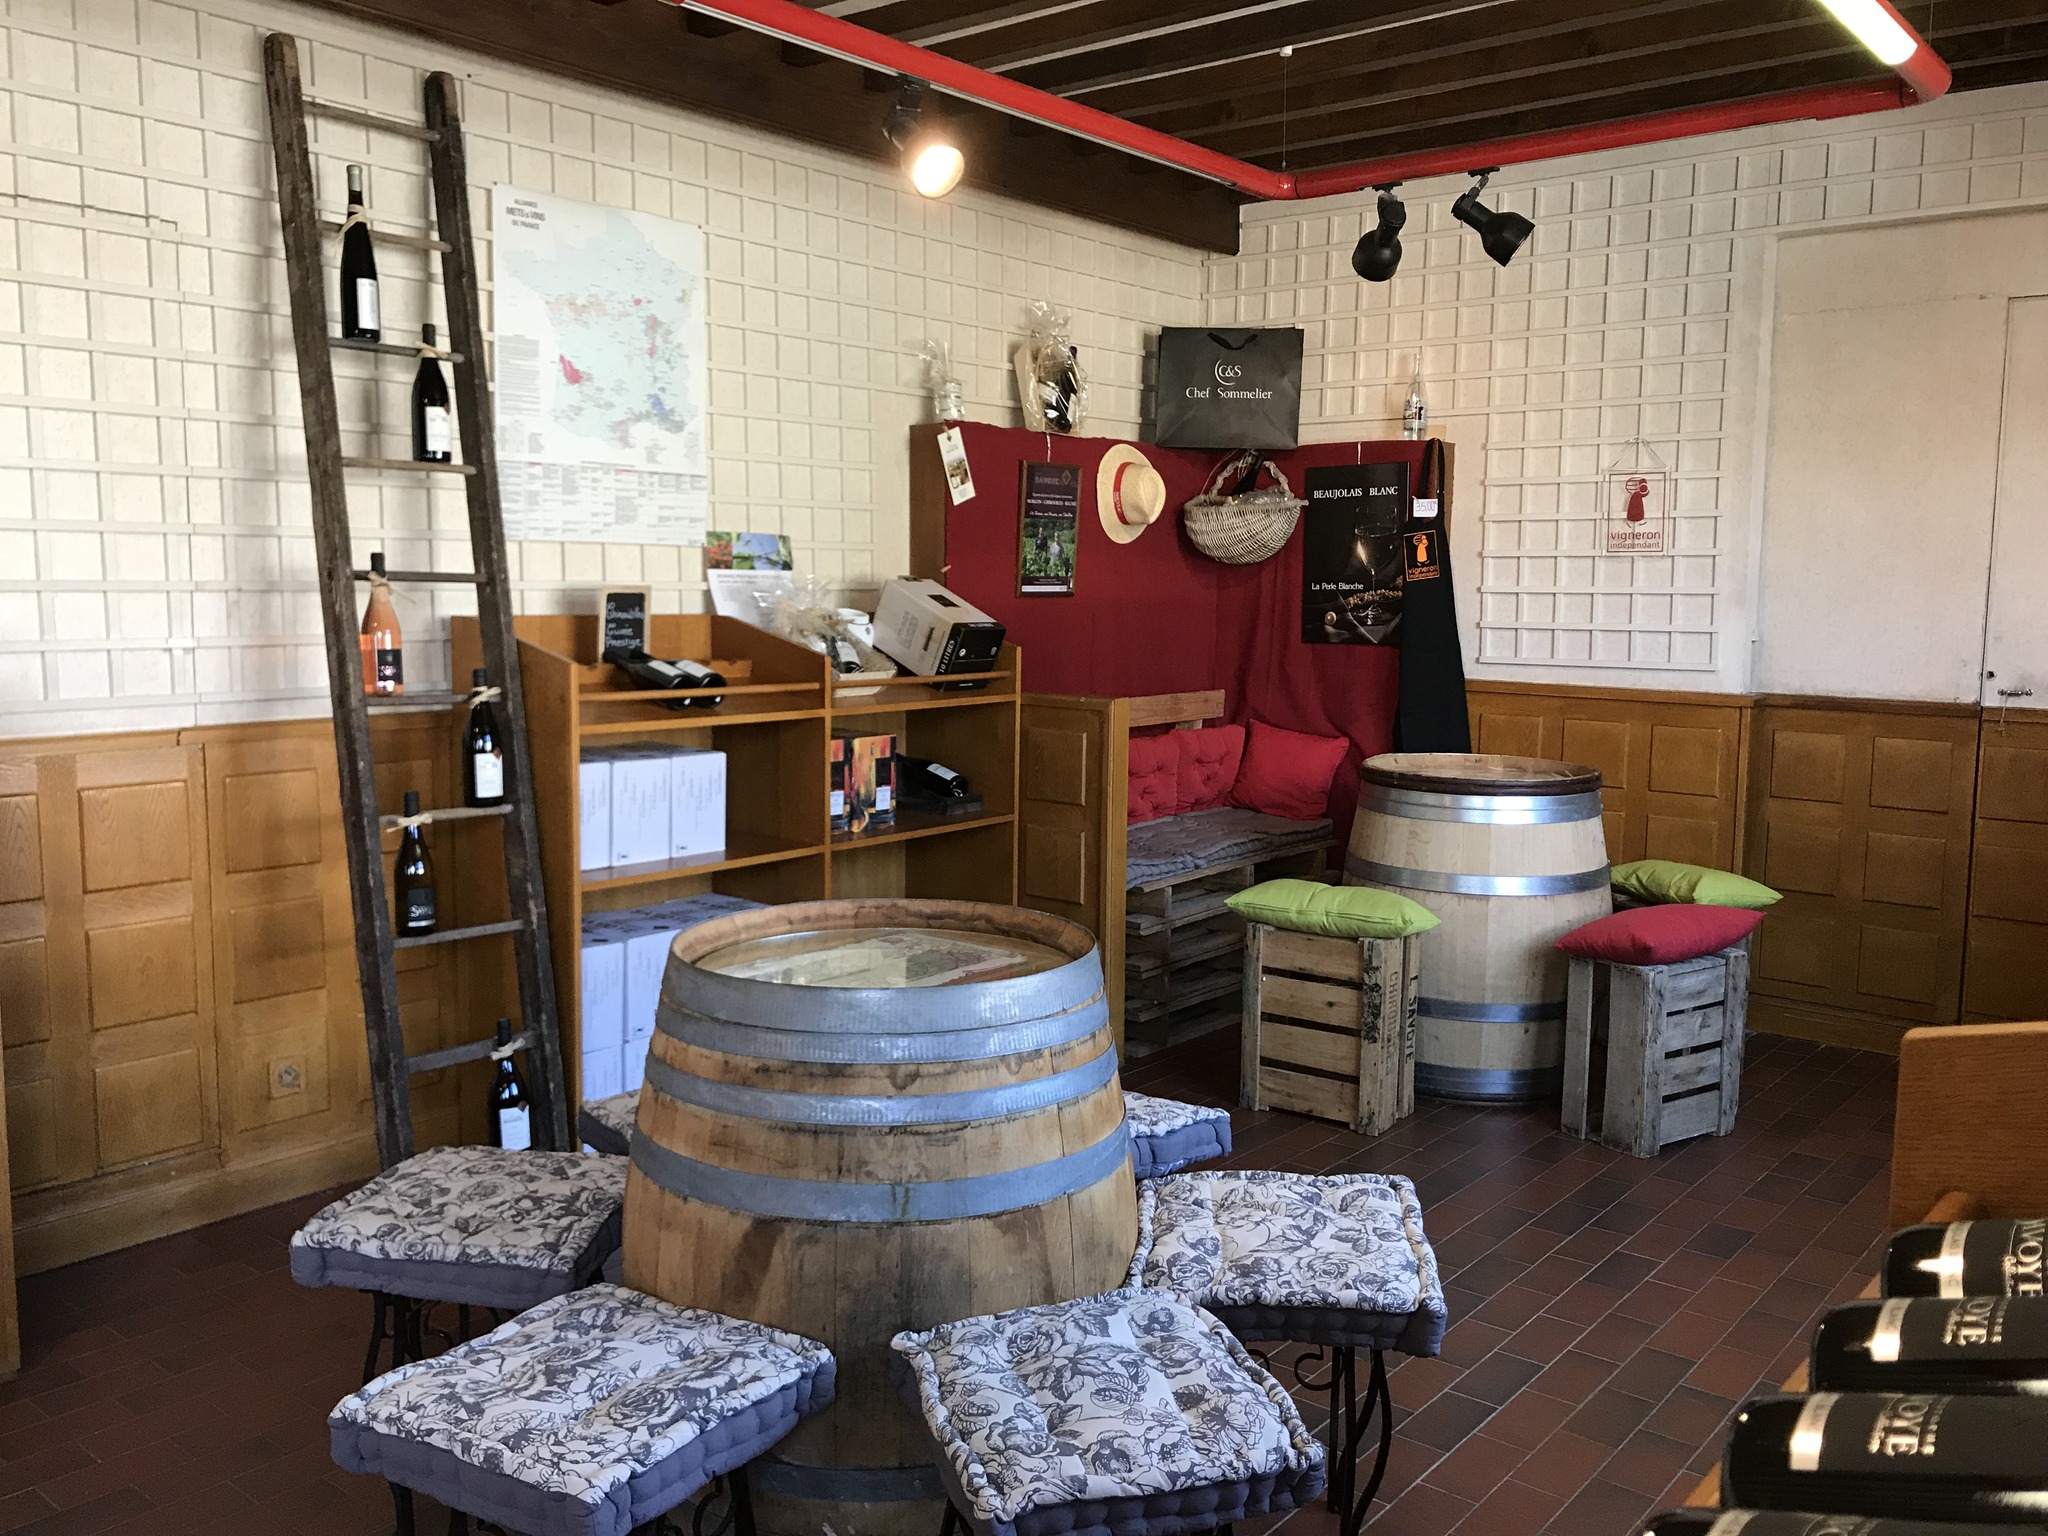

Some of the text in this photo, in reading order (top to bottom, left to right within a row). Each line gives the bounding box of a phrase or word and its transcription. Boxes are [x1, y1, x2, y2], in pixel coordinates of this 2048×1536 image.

[1218, 364, 1242, 378] C&S
[1186, 387, 1273, 400] Chef Sommelier
[1313, 486, 1399, 500] BEAUJOLAIS BLANC
[1610, 530, 1661, 542] vigneron
[1408, 565, 1439, 575] vigneron
[1321, 582, 1337, 590] Perle
[1338, 582, 1364, 590] Blanche
[939, 640, 956, 673] 10 LITRES
[1405, 995, 1418, 1064] SAVOYE
